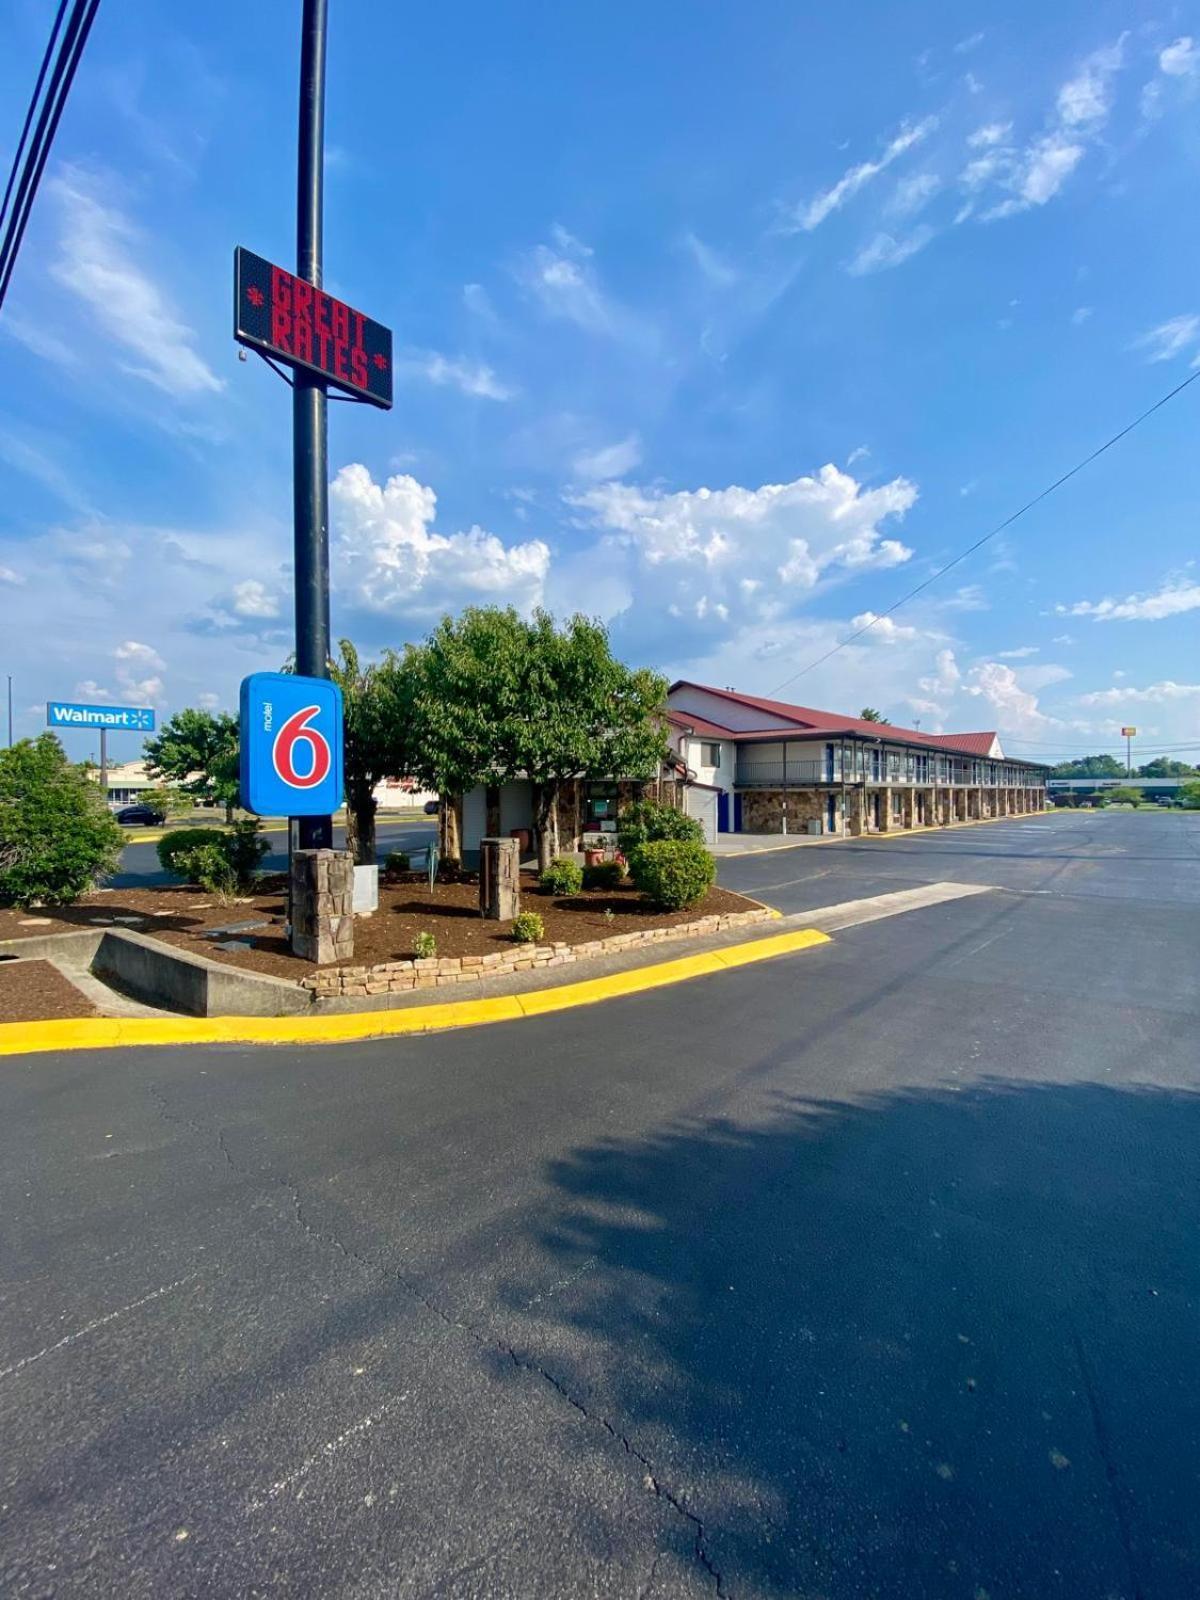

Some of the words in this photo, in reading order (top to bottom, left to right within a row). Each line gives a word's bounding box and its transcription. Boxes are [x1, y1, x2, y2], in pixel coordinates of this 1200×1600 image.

[272, 264, 367, 348] GREAT
[272, 305, 369, 390] RATES
[53, 707, 129, 725] Walmart
[262, 702, 273, 732] motel
[272, 704, 332, 789] 6
